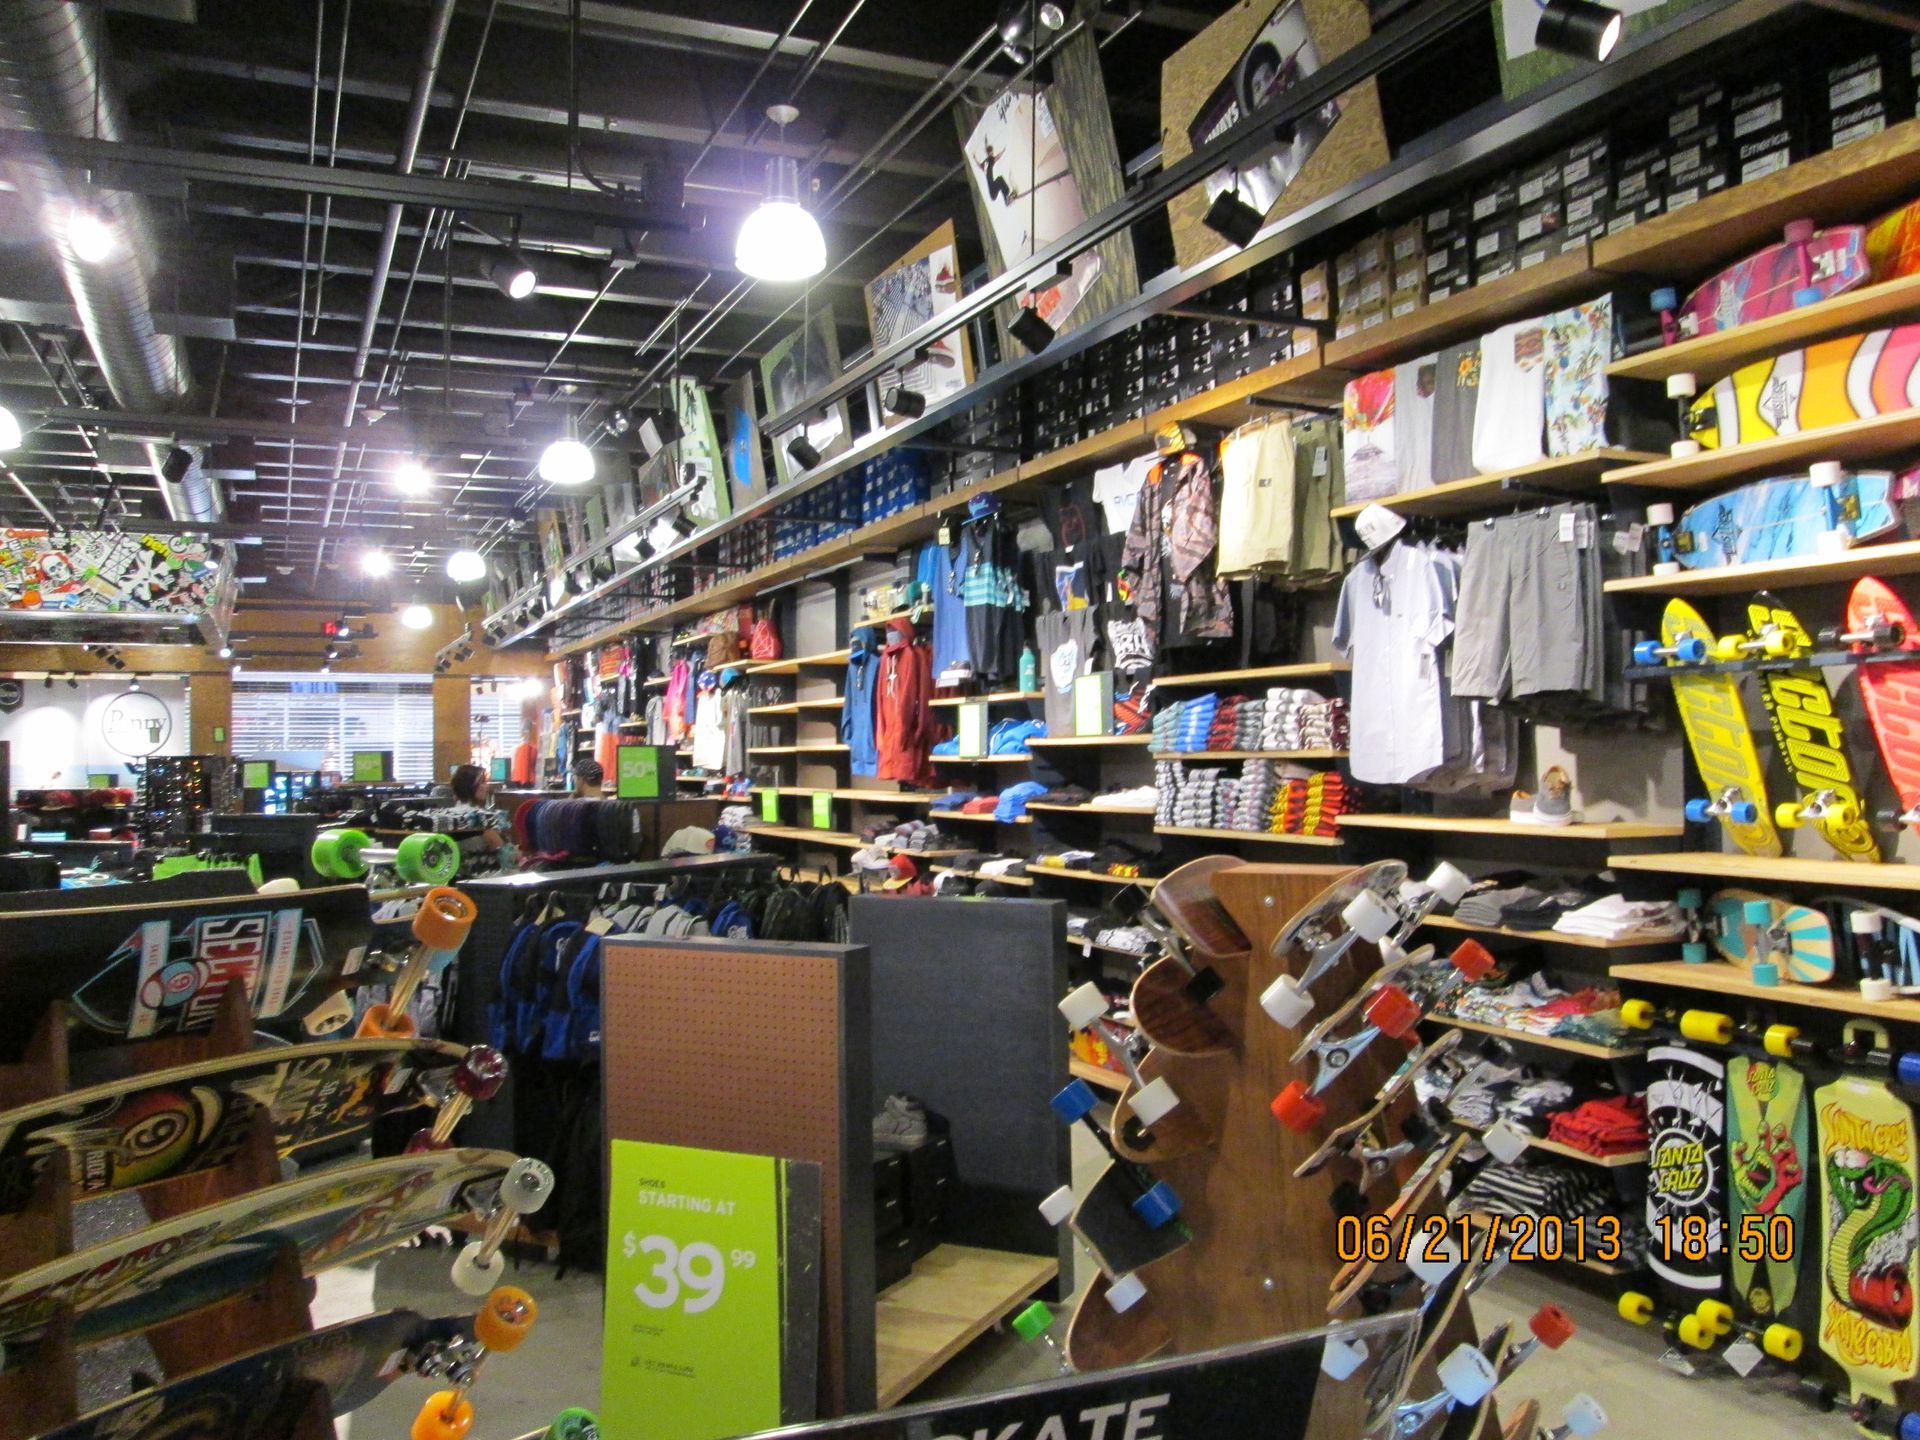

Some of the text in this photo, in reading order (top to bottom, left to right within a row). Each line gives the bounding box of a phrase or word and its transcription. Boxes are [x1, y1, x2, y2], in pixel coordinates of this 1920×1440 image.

[1651, 1142, 1705, 1170] SANTA
[1657, 1166, 1704, 1194] CRUZ
[638, 1190, 737, 1216] STARTING AT
